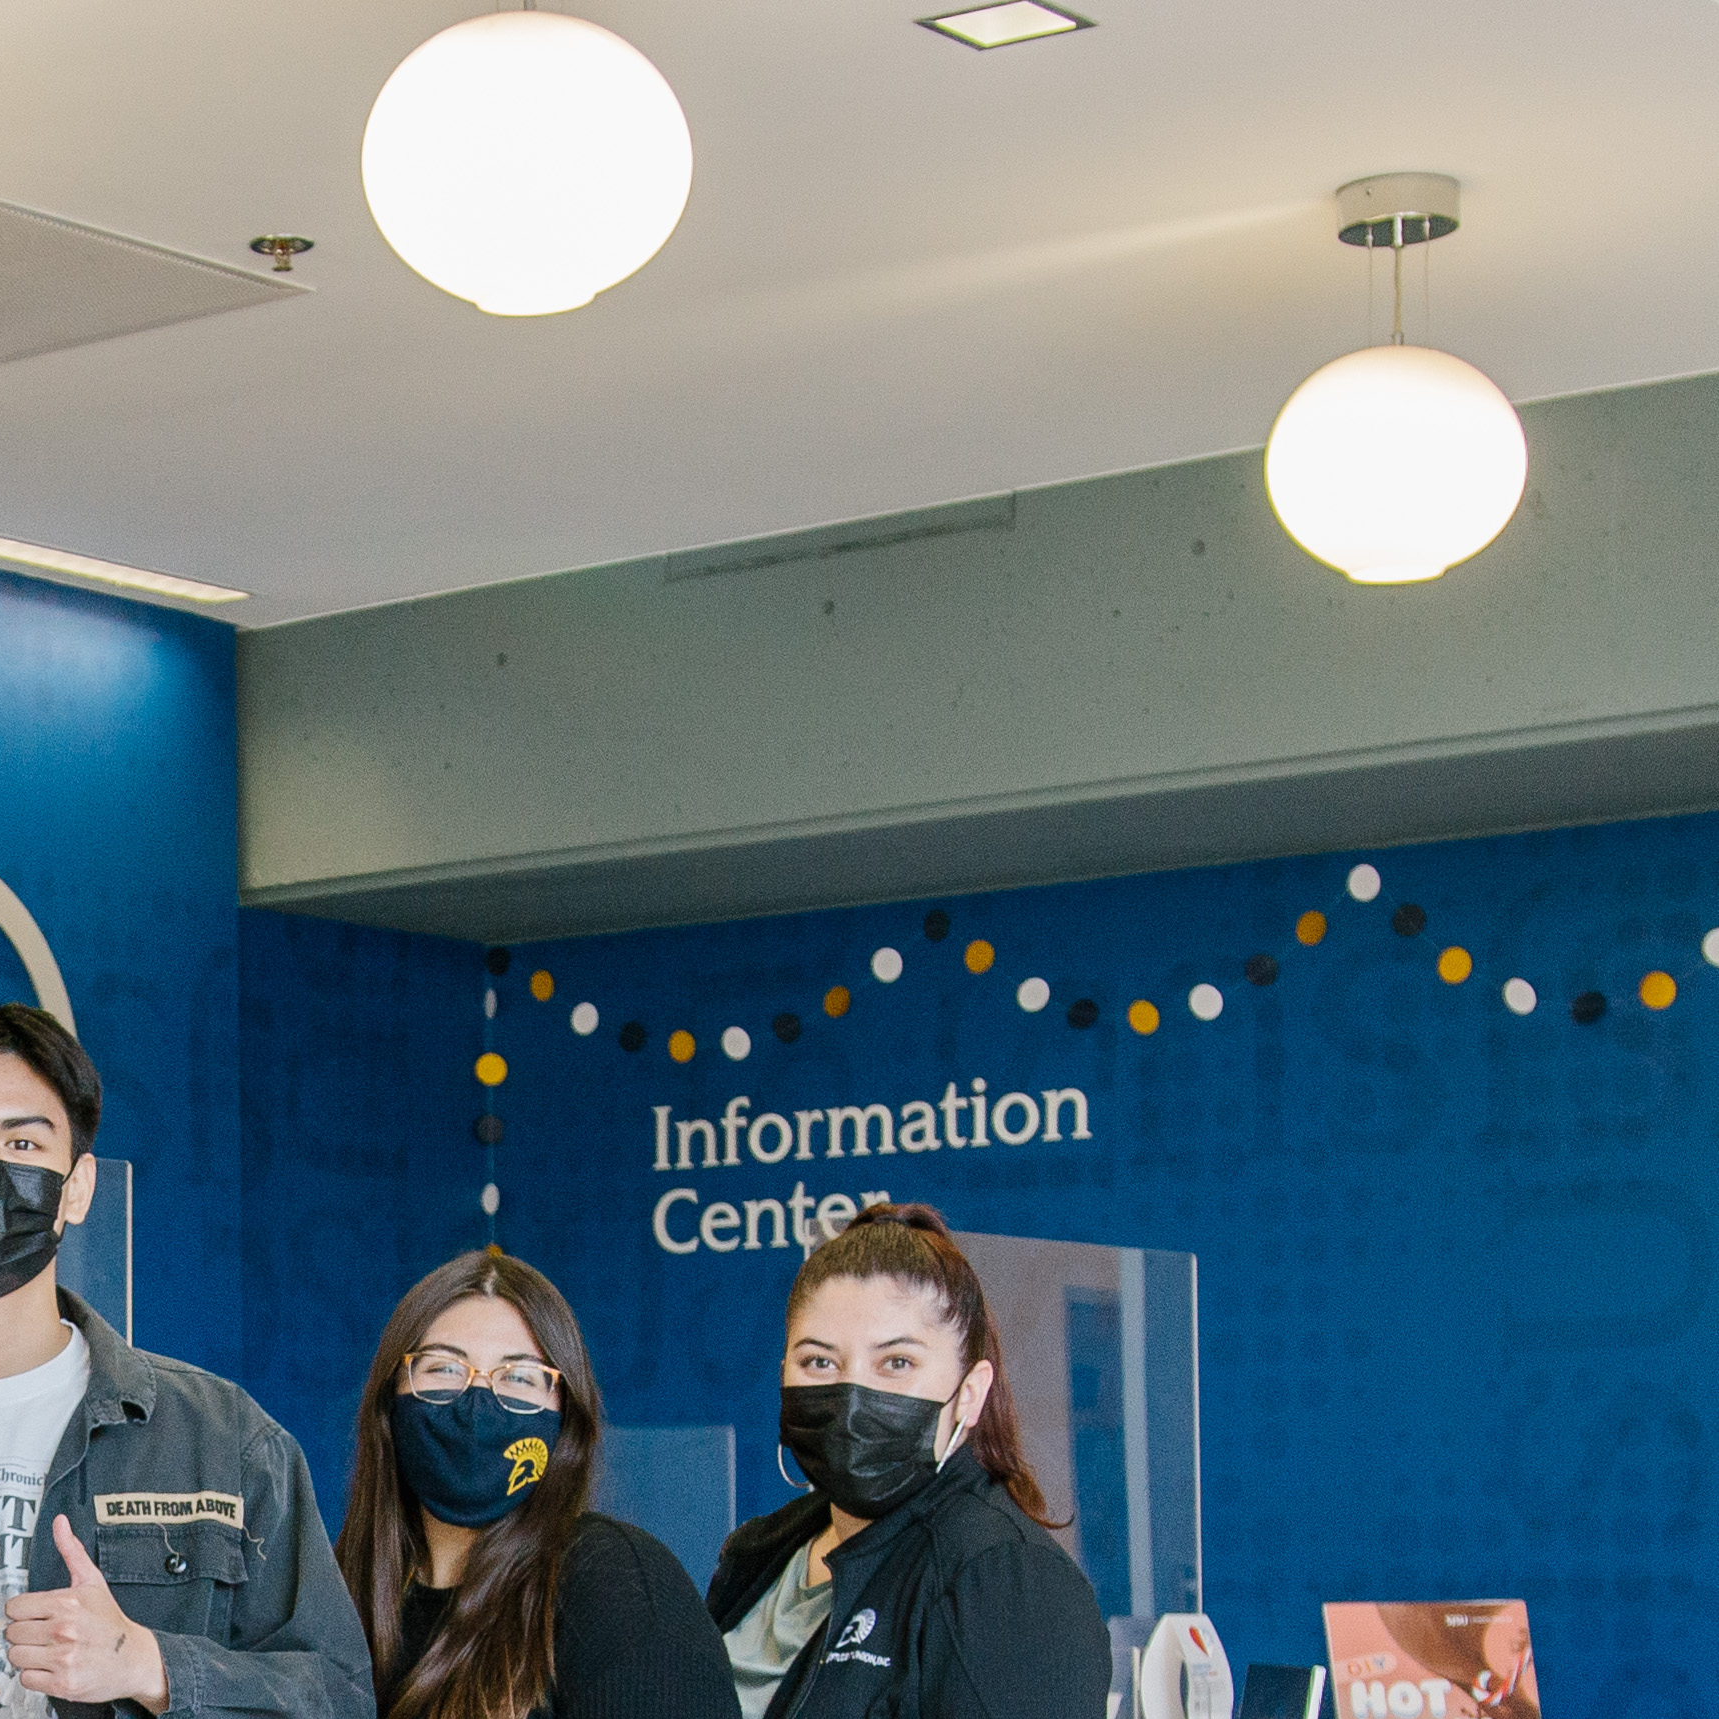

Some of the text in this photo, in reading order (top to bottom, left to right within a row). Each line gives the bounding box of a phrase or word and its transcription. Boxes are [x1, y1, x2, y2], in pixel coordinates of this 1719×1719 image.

[652, 1077, 1092, 1171] Information
[106, 1498, 236, 1519] DEATH FROM ABOVE
[1350, 1677, 1452, 1719] HOT
